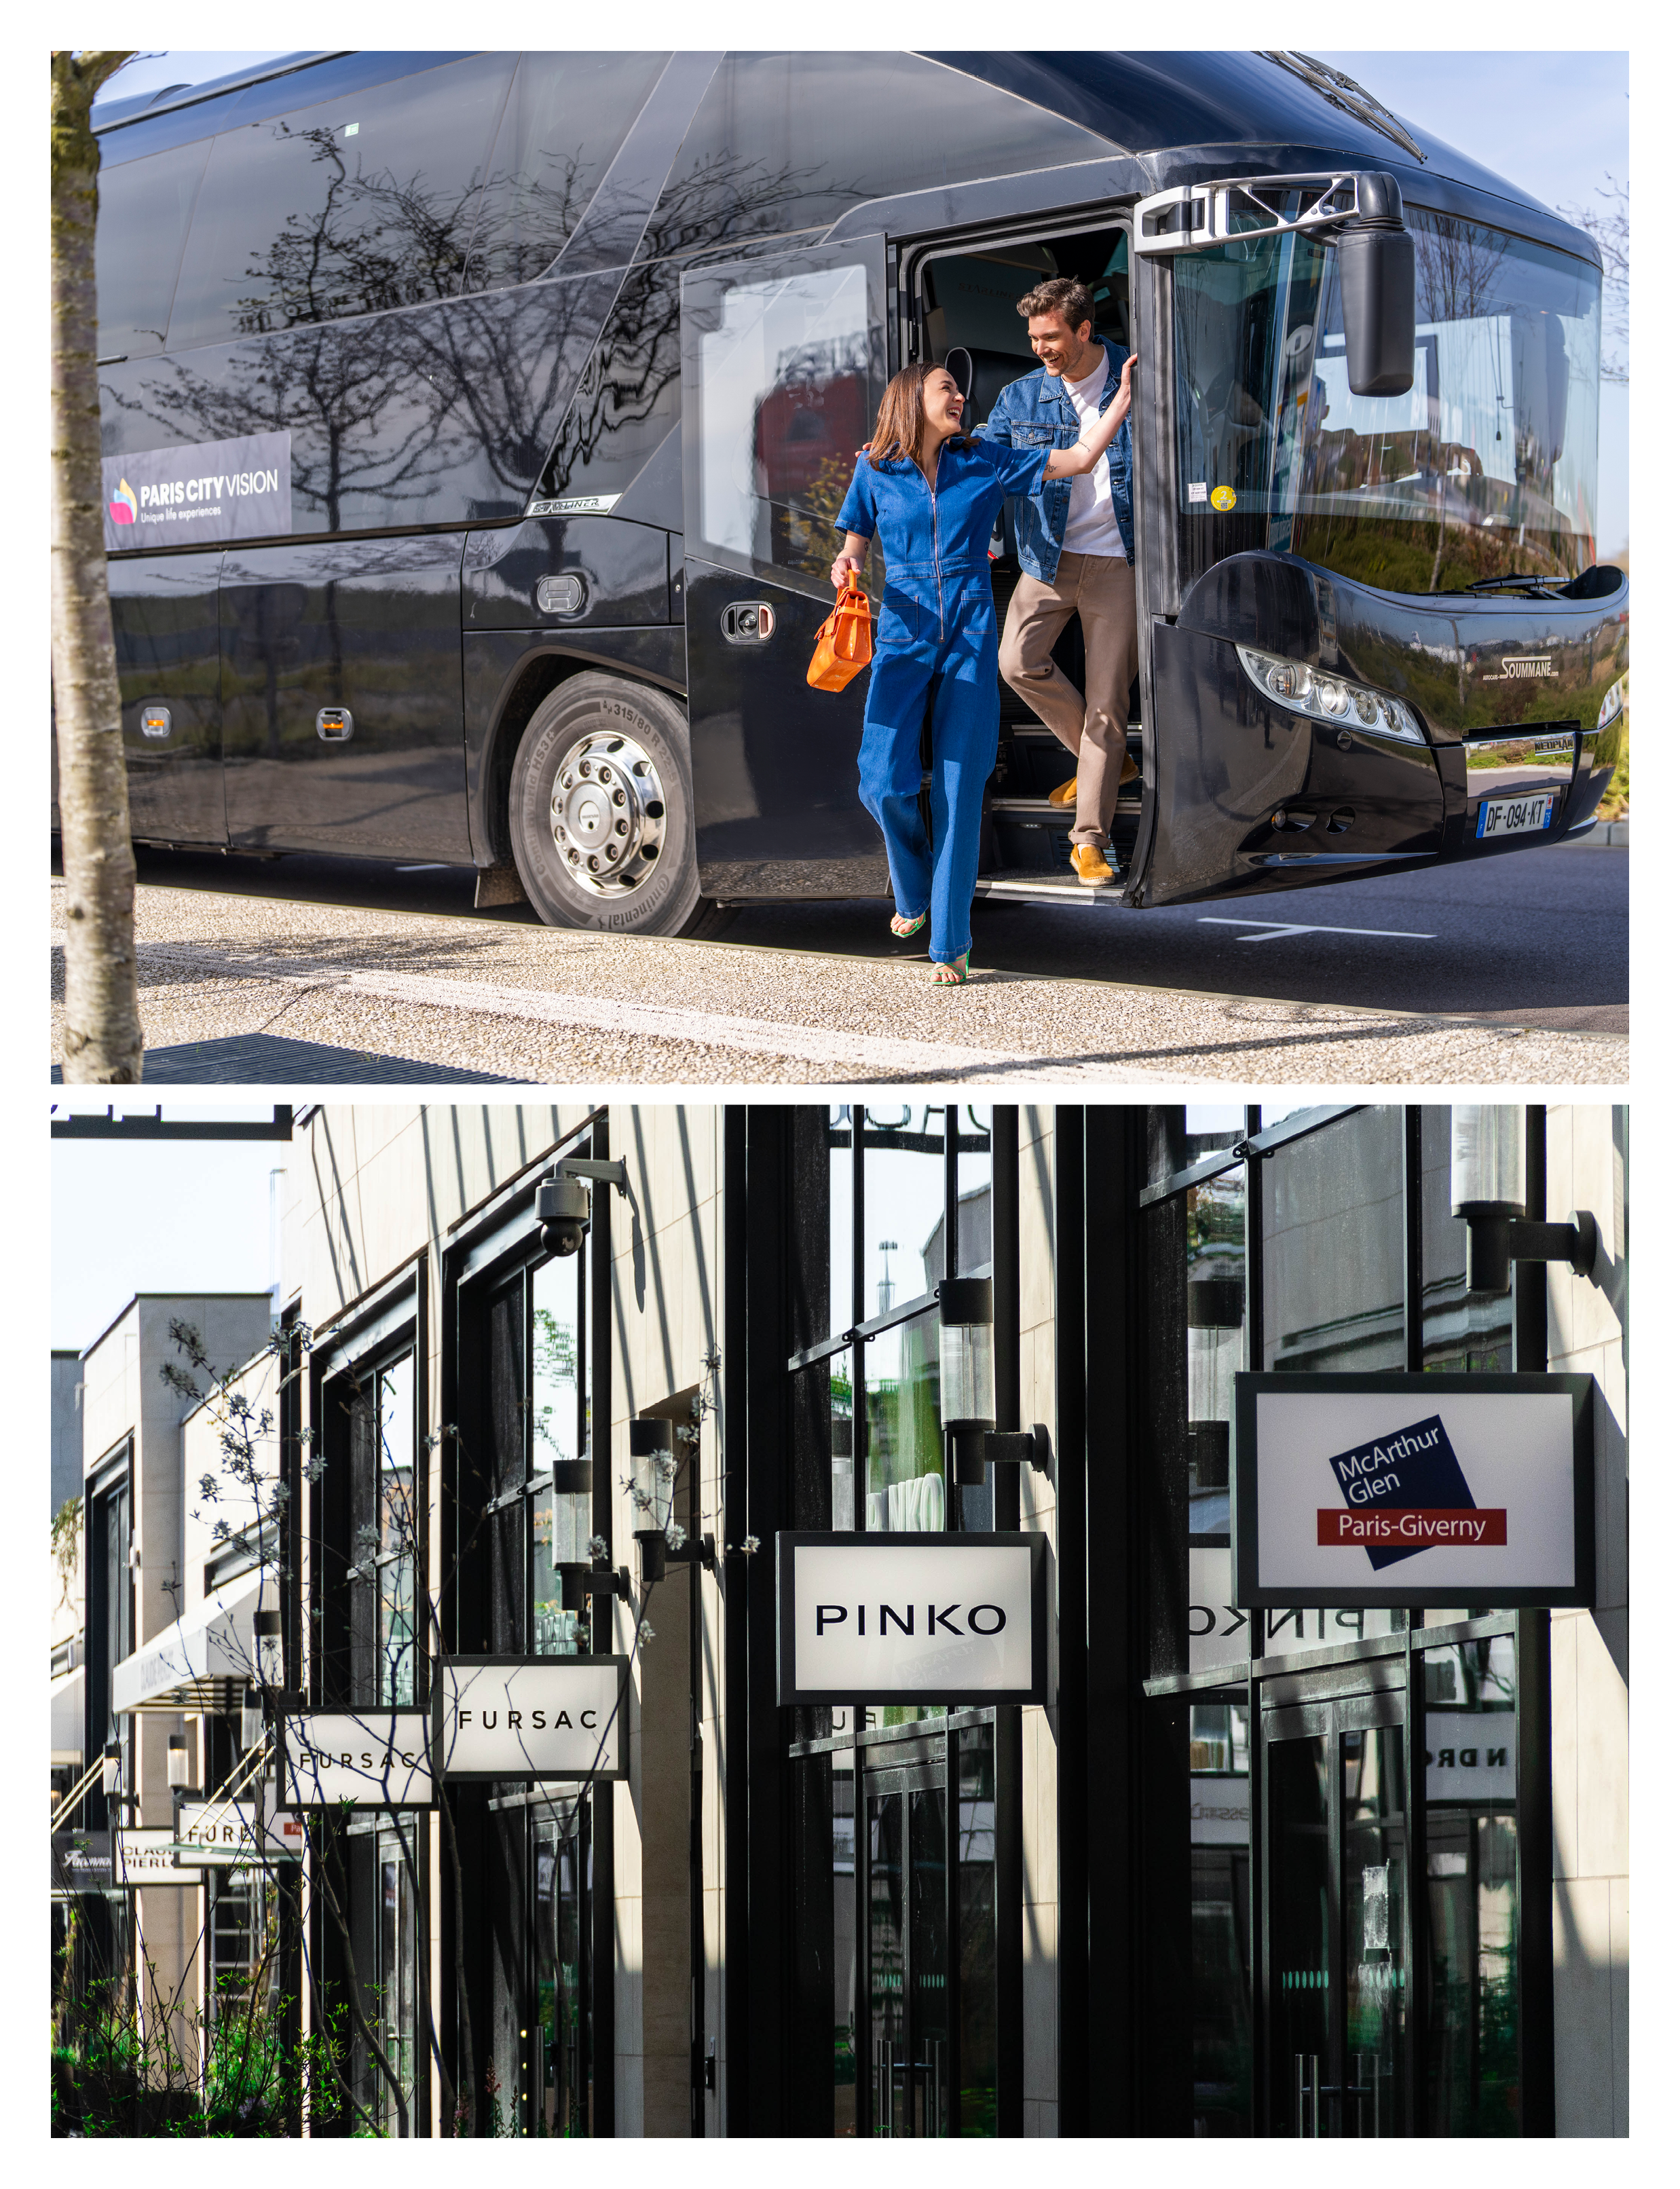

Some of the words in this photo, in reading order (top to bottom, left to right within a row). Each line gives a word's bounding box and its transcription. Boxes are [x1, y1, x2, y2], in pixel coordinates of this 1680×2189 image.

[141, 481, 185, 508] PARIS
[186, 476, 225, 502] CITY
[225, 469, 278, 497] VISION
[1220, 491, 1227, 500] 2
[141, 512, 164, 525] Unique
[166, 508, 176, 521] life
[178, 506, 222, 522] experiences
[534, 498, 599, 513] STARLINER
[651, 733, 660, 747] R
[1535, 736, 1573, 751] NEOPLAN
[1486, 800, 1545, 832] DF-094-KT
[608, 874, 670, 930] Continental
[1338, 1427, 1440, 1481] McArthur
[1348, 1472, 1401, 1503] Glen
[1339, 1514, 1487, 1541] Paris-Giverny
[816, 1604, 1007, 1636] PINKO
[458, 1710, 597, 1730] FURSAC
[299, 1753, 416, 1769] FURSAC
